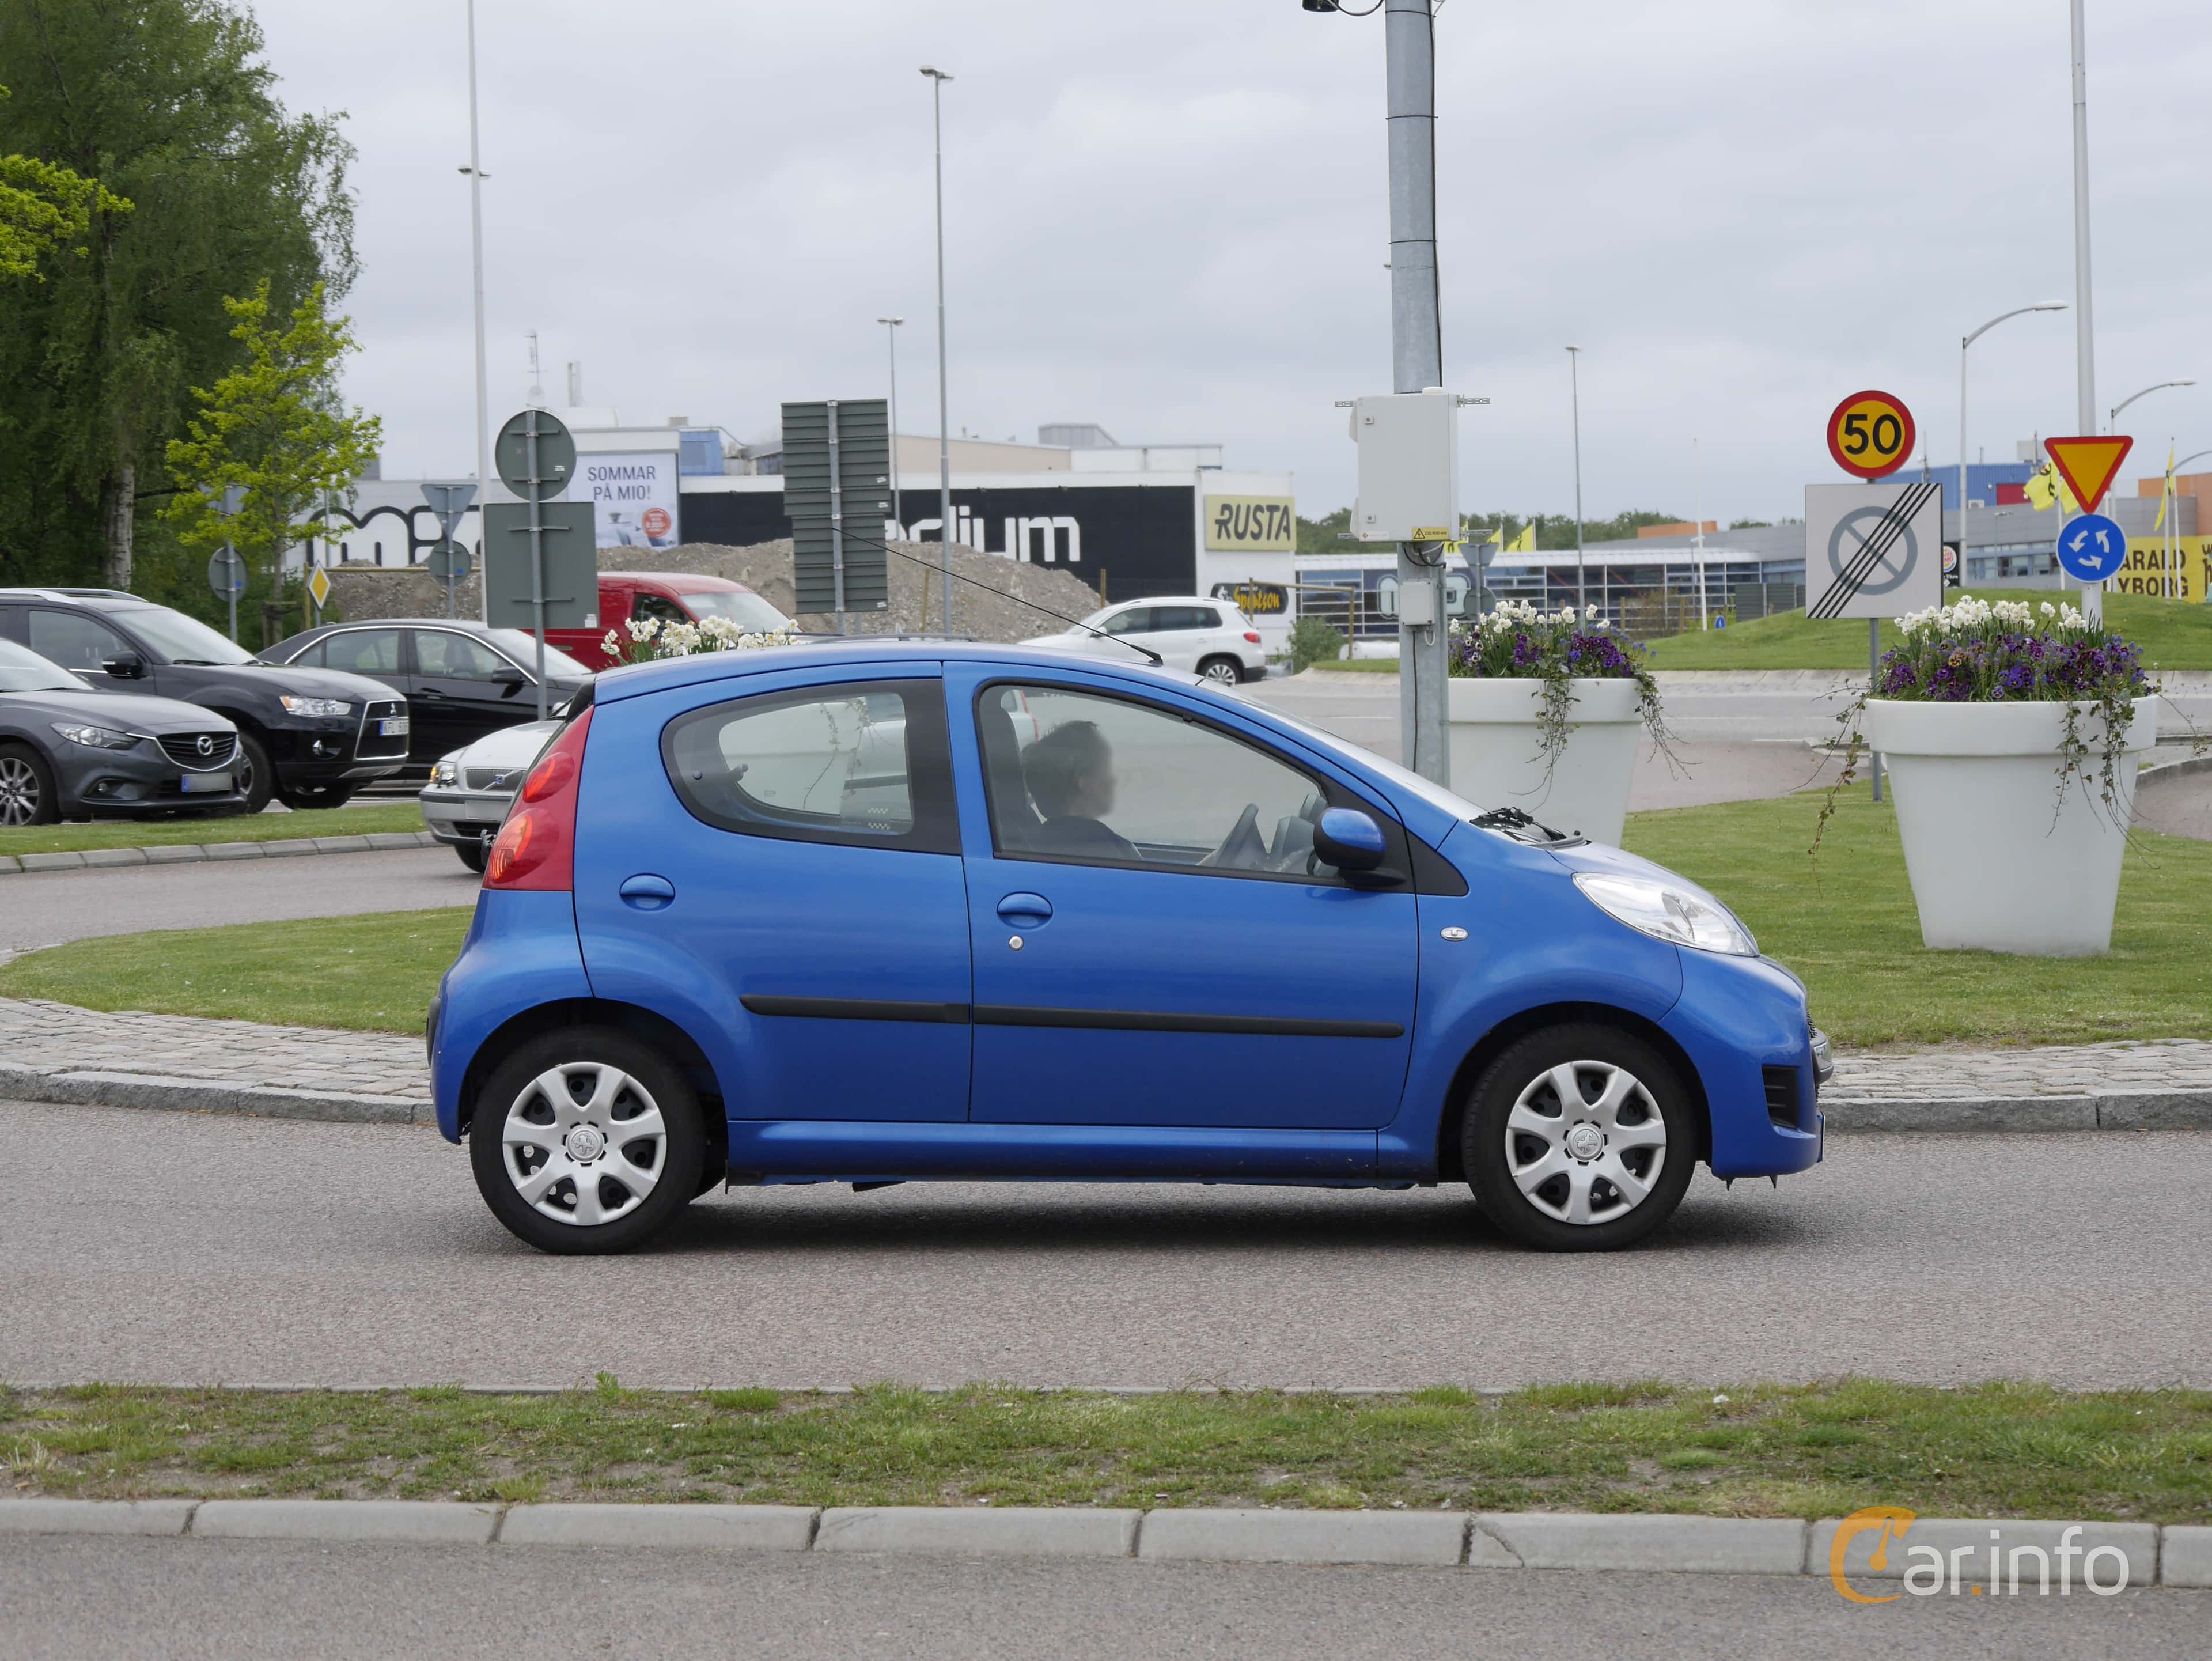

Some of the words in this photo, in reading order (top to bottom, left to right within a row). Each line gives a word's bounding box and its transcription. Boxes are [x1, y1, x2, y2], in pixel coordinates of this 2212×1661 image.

[1844, 414, 1902, 455] 50
[588, 466, 656, 481] SOMMAR
[594, 483, 612, 500] PÅ
[618, 485, 650, 500] MIO!
[1215, 503, 1291, 541] RUSTA
[2120, 550, 2186, 570] ARALD
